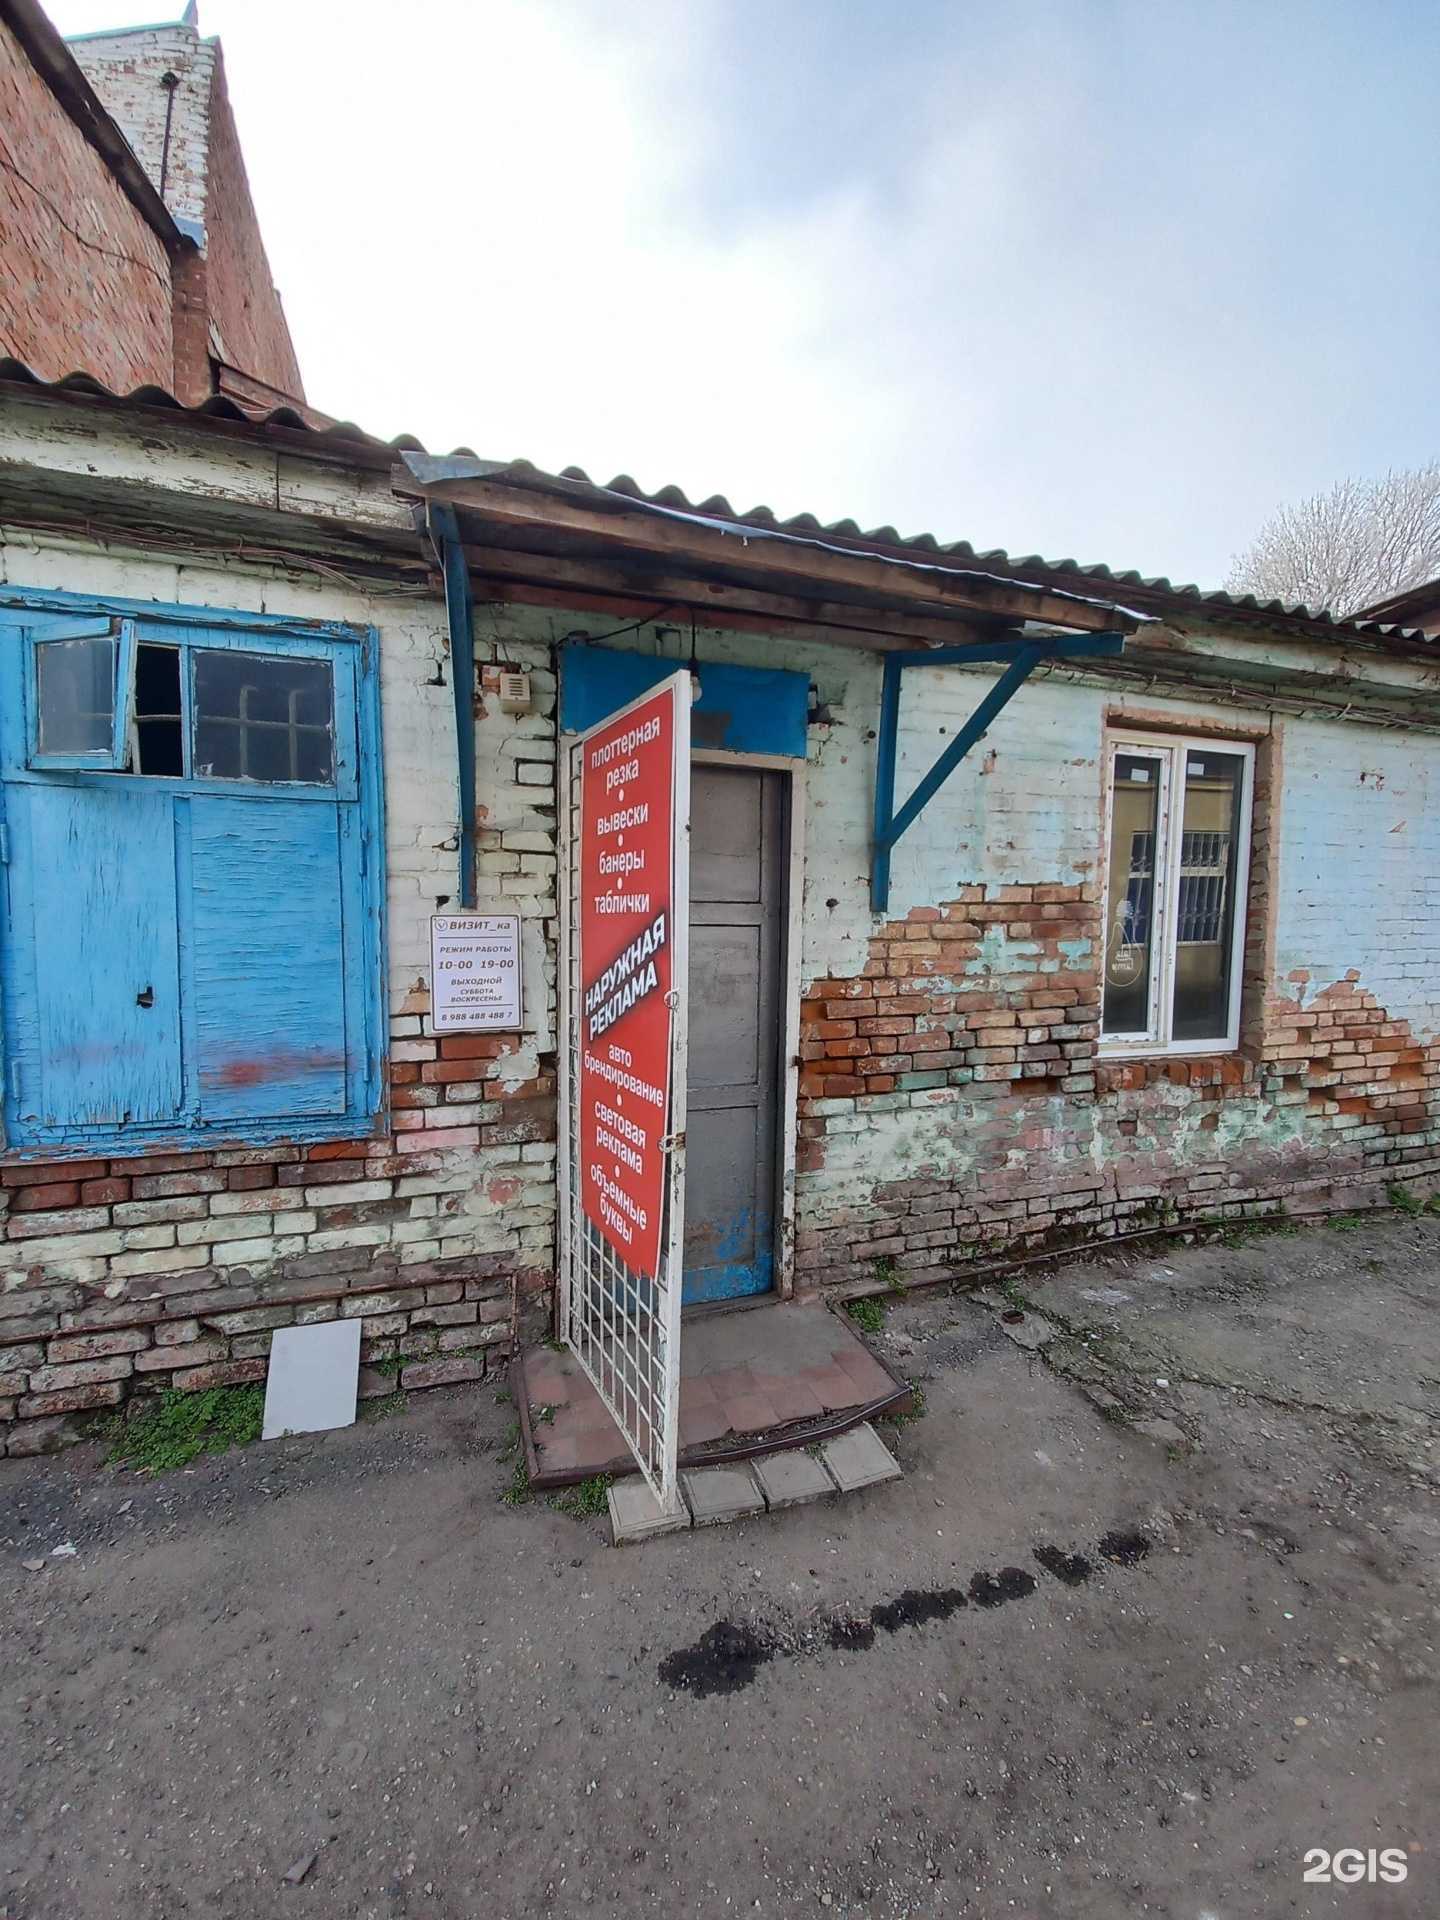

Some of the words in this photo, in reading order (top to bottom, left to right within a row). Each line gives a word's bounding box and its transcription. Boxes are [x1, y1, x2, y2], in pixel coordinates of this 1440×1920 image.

[591, 716, 661, 768] плоттерная
[606, 760, 639, 794] резка
[597, 802, 648, 836] вывески
[599, 849, 645, 876] банеры
[594, 890, 650, 914] таблички
[438, 960, 473, 969] 10-00
[480, 959, 514, 969] 19-00
[450, 977, 503, 986] ВЫХОДНОЙ
[585, 913, 665, 1017] НАРУЖНАЯ
[450, 995, 503, 1003] ВОСКРЕСЕНЬЕ
[589, 961, 658, 1041] РЕКЛАМА
[608, 1043, 632, 1068] авто
[584, 1049, 664, 1109] брендирование
[594, 1100, 646, 1150] световая
[595, 1125, 643, 1176] реклама
[590, 1164, 648, 1231] объемные
[599, 1191, 633, 1245] буквы
